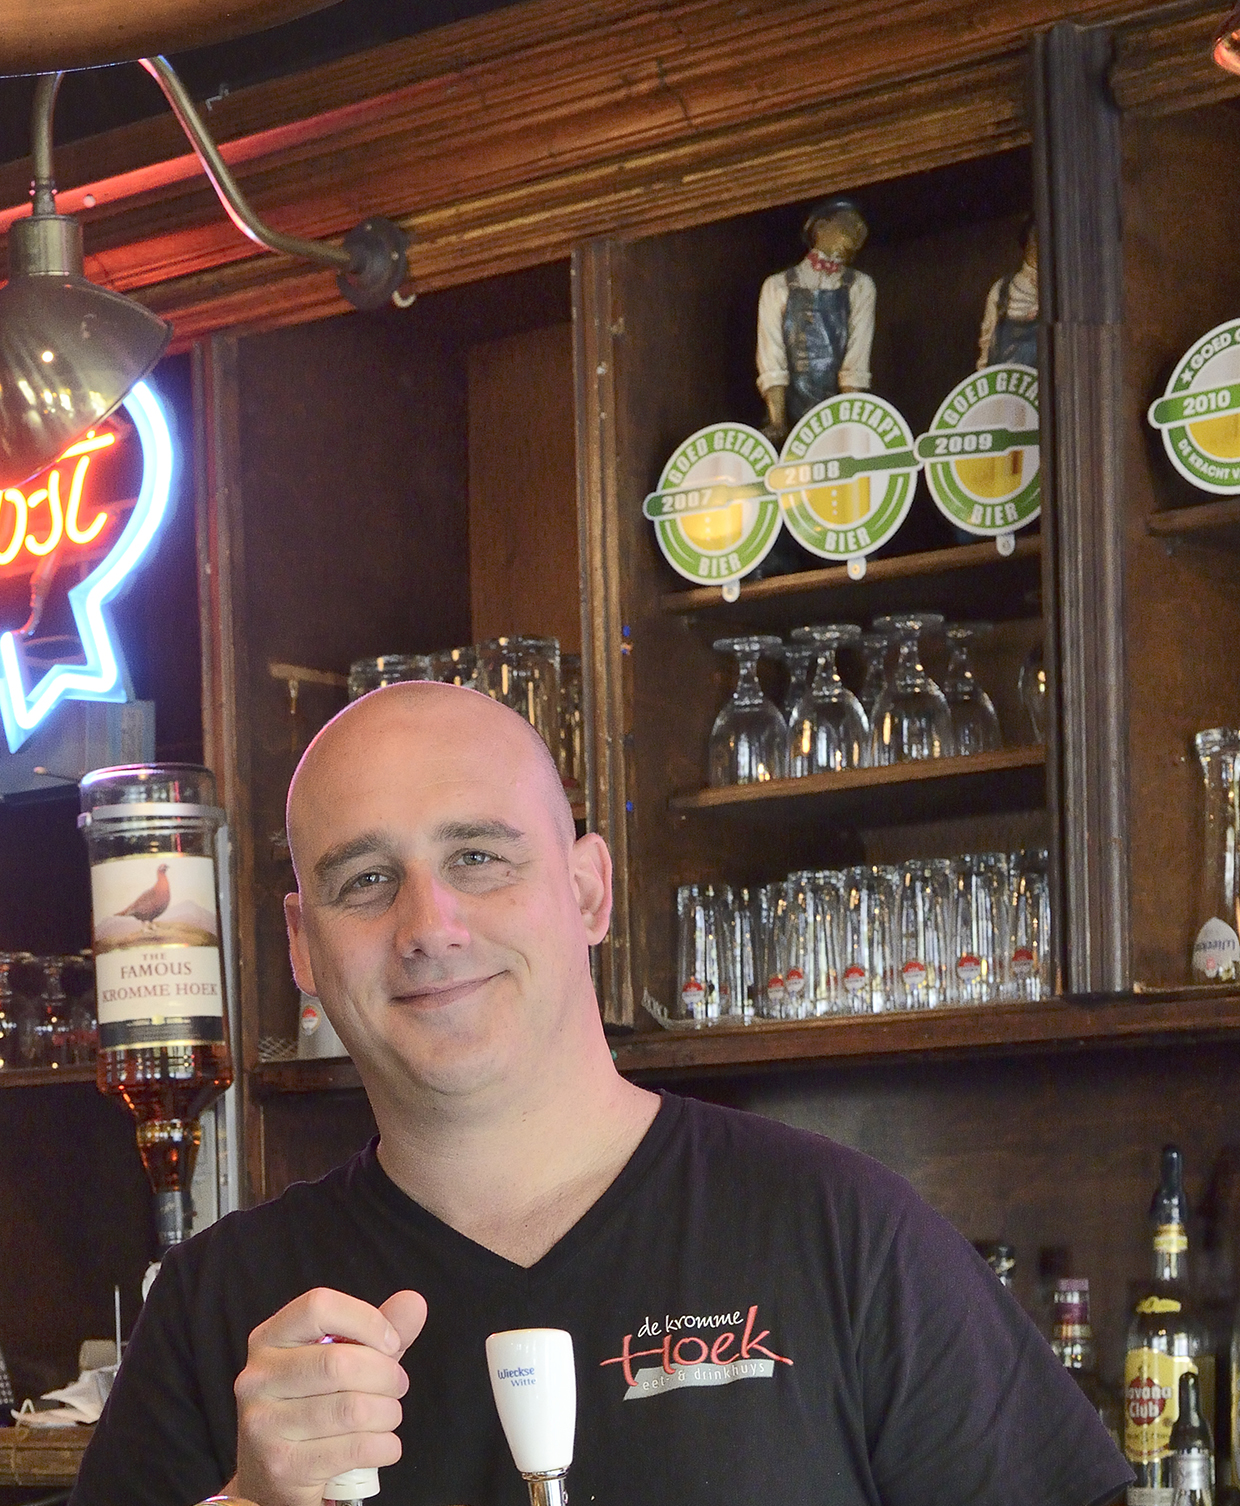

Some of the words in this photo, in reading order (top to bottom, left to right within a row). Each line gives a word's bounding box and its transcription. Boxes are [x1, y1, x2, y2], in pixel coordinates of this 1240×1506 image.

[1190, 332, 1231, 370] GOED
[942, 377, 989, 426] GOED
[995, 371, 1039, 406] GETA
[1183, 390, 1230, 416] 2010
[791, 408, 833, 456] GOED
[839, 400, 902, 443] GETAPT
[934, 433, 992, 454] 2009
[668, 438, 709, 485] GOED
[713, 430, 772, 472] GETAPT
[784, 460, 840, 485] 2008
[662, 489, 712, 513] 2007
[970, 502, 1018, 526] BIER
[824, 526, 871, 551] BIER
[698, 552, 742, 577] BIER
[142, 953, 166, 961] THE
[121, 961, 192, 979] FAMOUS
[102, 983, 171, 1003] KROMME
[176, 982, 219, 996] HOEK
[637, 1316, 662, 1338] de
[665, 1310, 744, 1333] kromme
[599, 1305, 794, 1387] Hoek
[497, 1367, 535, 1380] Wieckse
[511, 1378, 536, 1387] Witte
[694, 1362, 765, 1381] drinkhuys
[1128, 1400, 1160, 1419] Club
